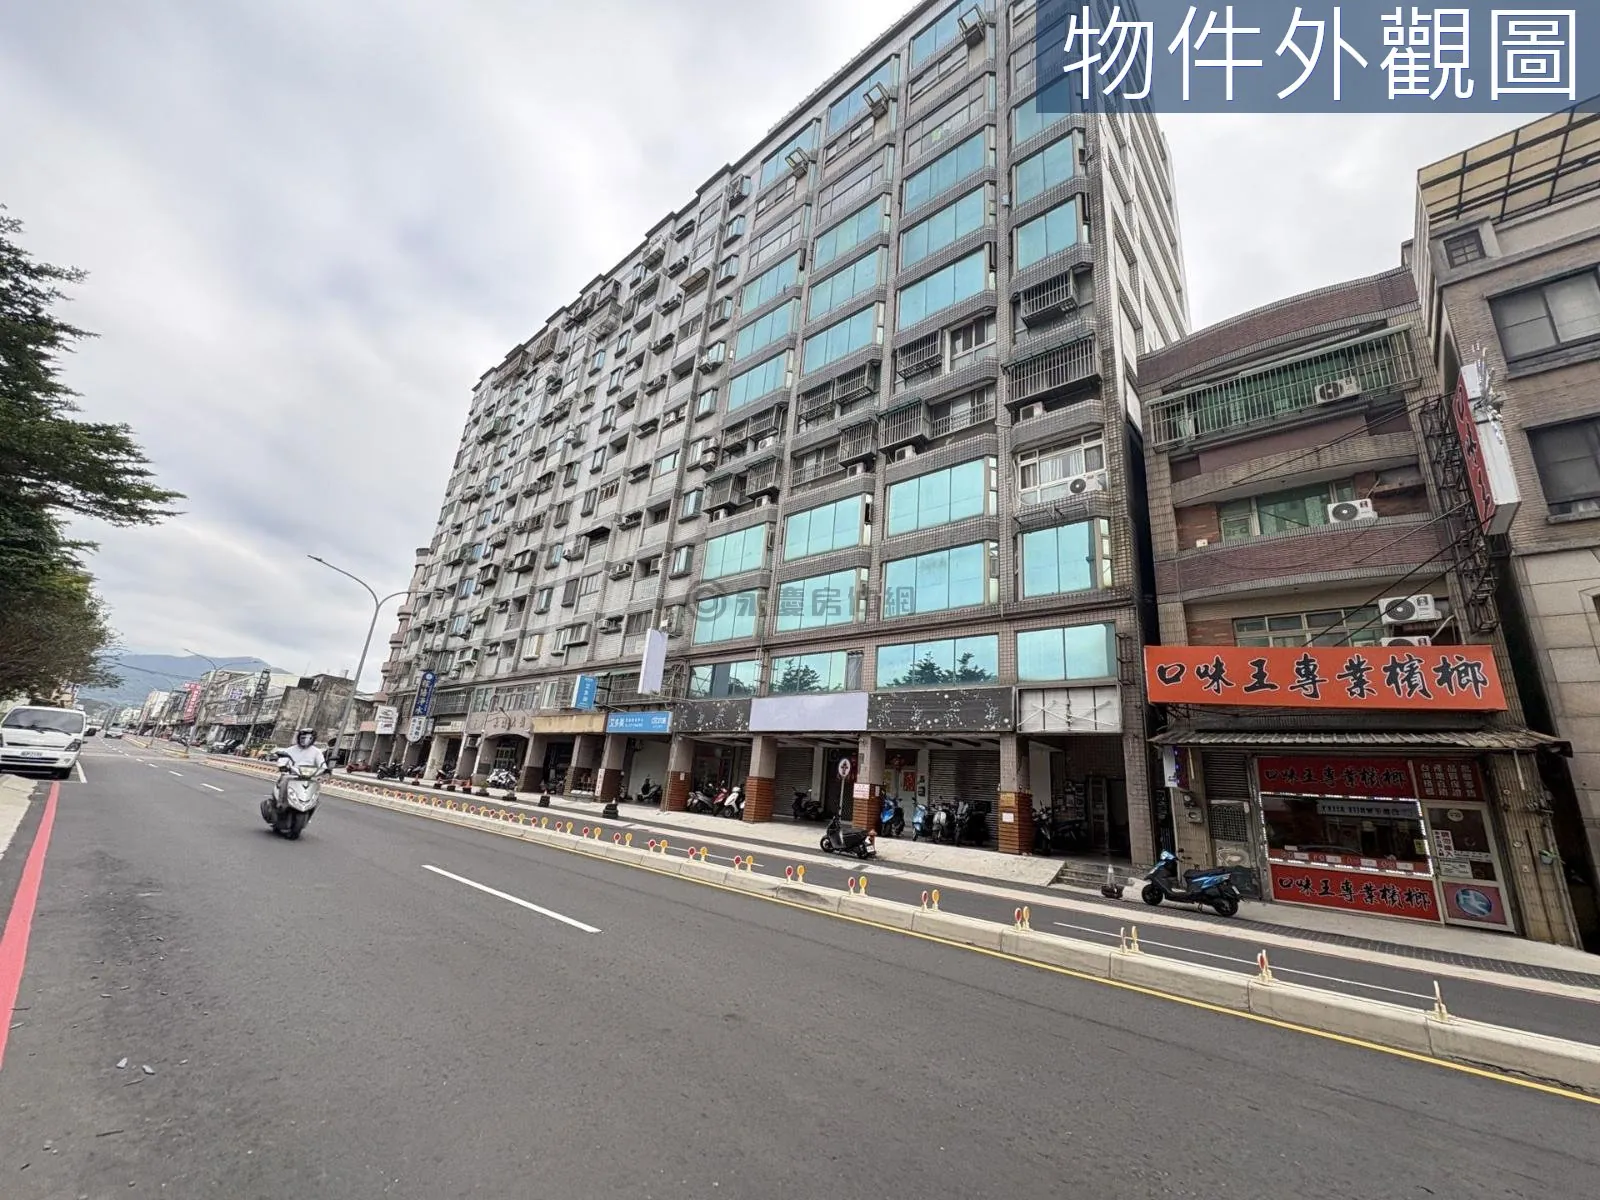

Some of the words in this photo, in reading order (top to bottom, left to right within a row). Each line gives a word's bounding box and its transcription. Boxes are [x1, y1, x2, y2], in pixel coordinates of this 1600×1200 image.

[1155, 653, 1490, 700] 口味王專業檳榔
[1264, 765, 1407, 789] 口味王專業檳榔
[1278, 876, 1432, 910] 口味王專業檳榔
